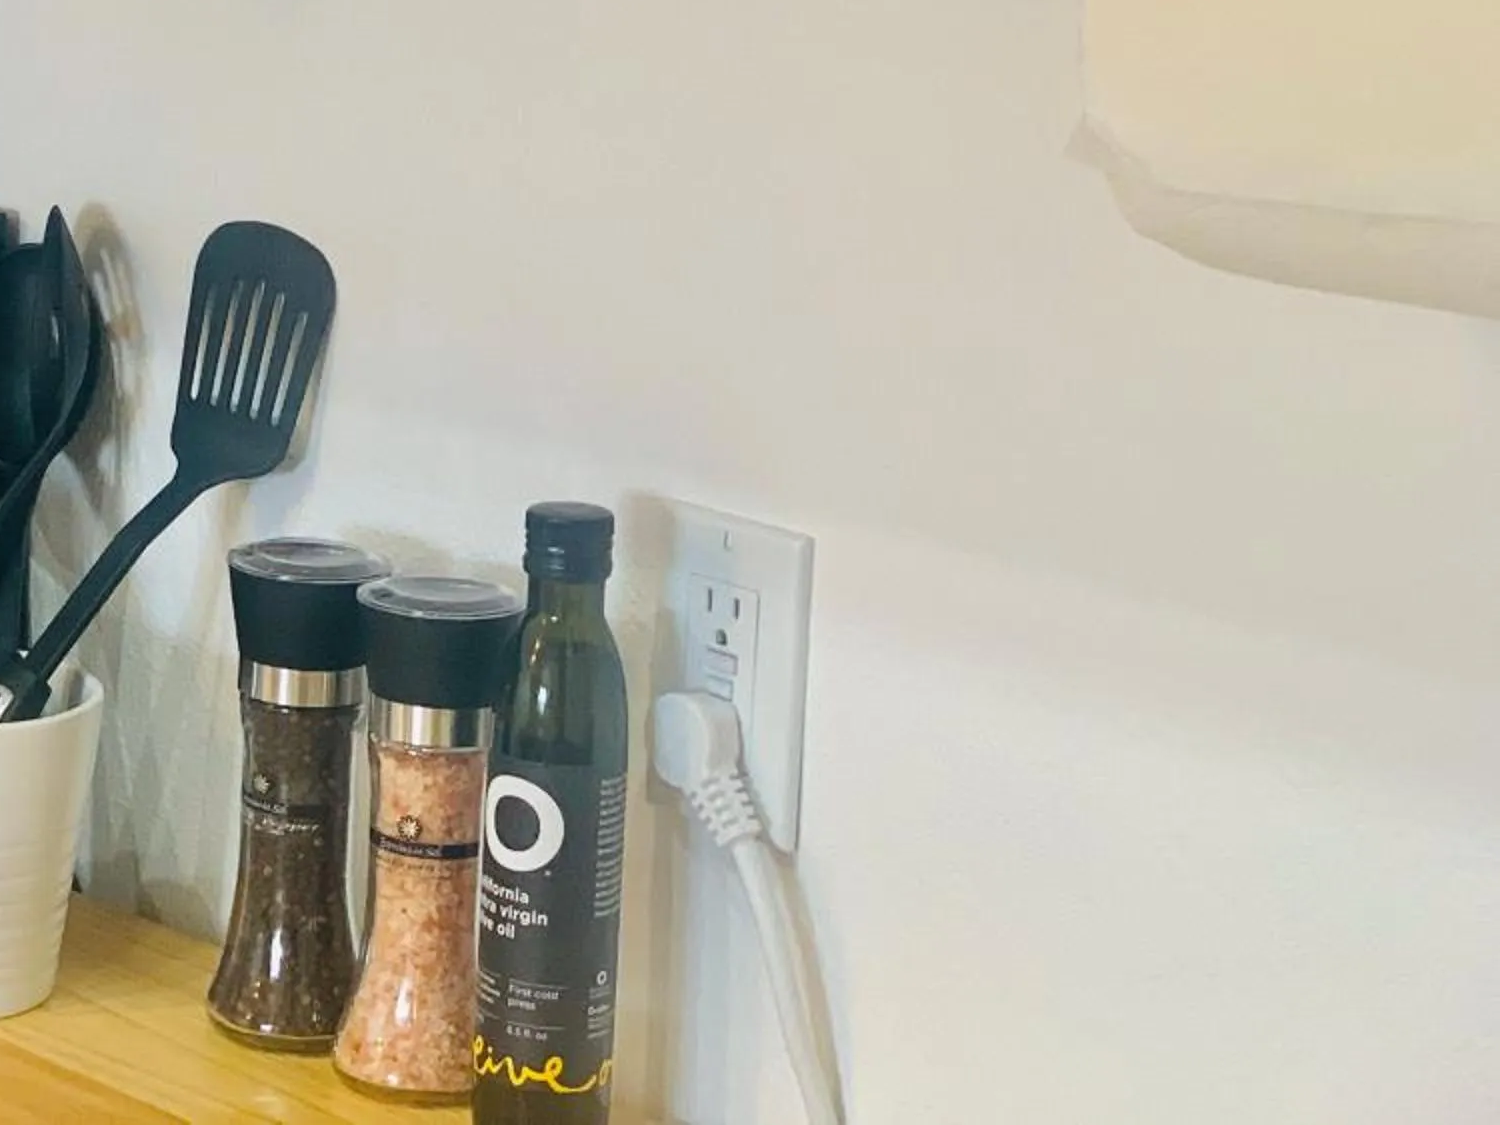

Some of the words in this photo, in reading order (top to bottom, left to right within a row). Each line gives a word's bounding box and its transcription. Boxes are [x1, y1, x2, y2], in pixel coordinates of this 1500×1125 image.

[500, 903, 549, 927] virgin
[497, 921, 515, 940] oil
[509, 984, 532, 997] First
[533, 989, 559, 1000] cold
[507, 997, 536, 1011] press
[473, 1035, 597, 1094] live
